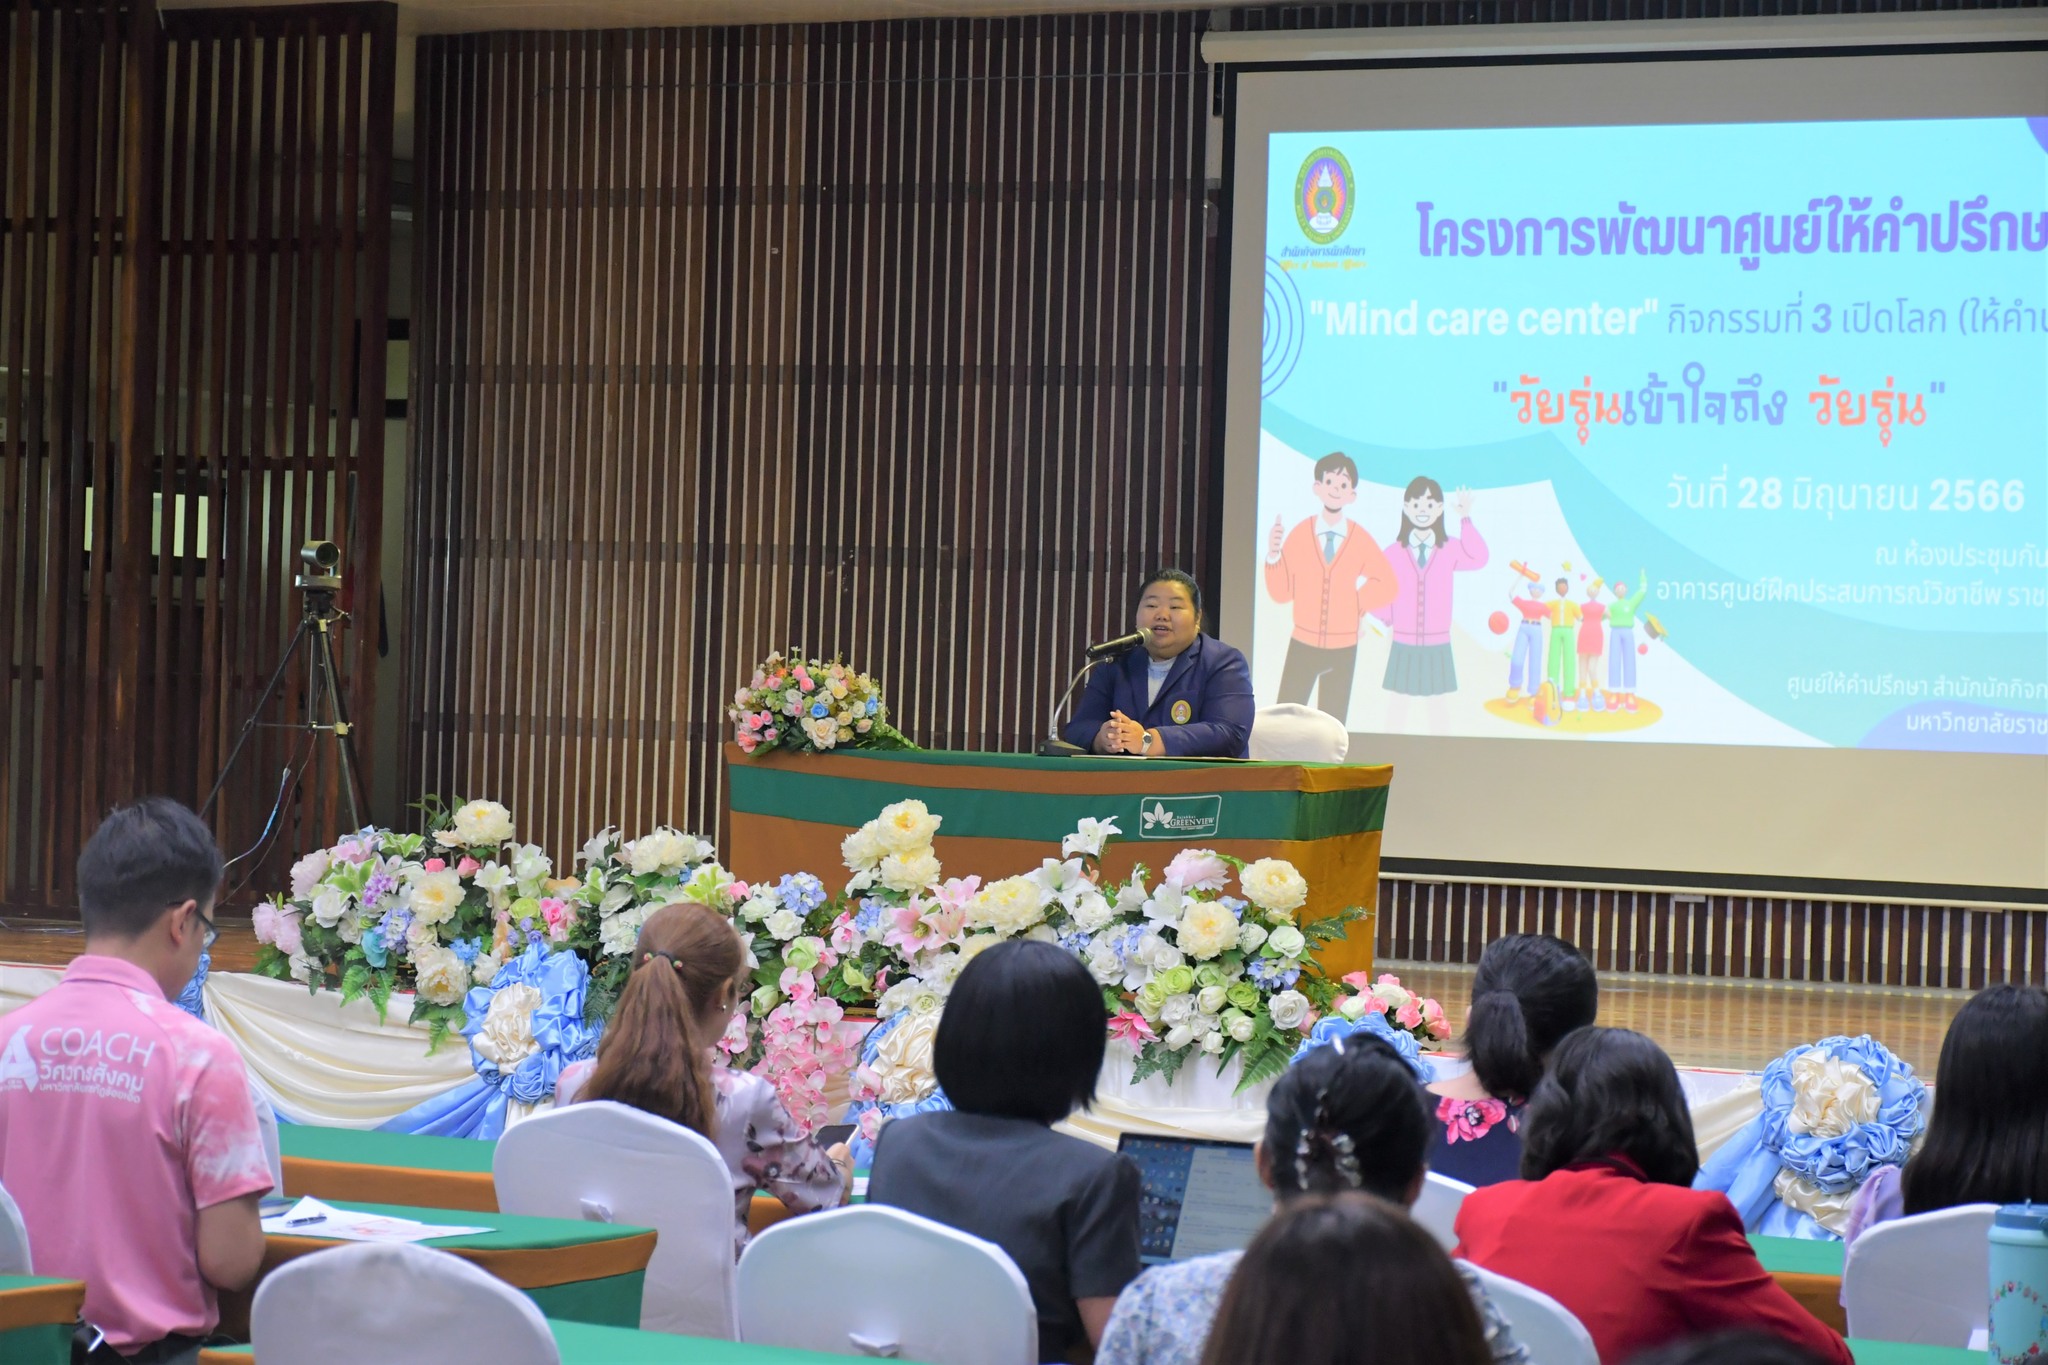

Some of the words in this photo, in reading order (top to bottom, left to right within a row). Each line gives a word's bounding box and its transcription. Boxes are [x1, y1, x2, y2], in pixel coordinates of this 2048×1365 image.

[1416, 194, 2048, 271] โครงการพัฒนาศูนย์ให้คำปรึกษ
[1310, 299, 1418, 336] "Mind
[1426, 308, 1509, 336] care
[1517, 298, 1659, 336] center"
[1668, 290, 1803, 334] กิจกรรมที่
[1812, 303, 1832, 333] 3
[1842, 298, 1947, 334] เปิดโลก
[1666, 464, 1728, 509] วันที่
[1738, 477, 1783, 509] 28
[1792, 477, 1919, 521] มิถุนายน
[1929, 479, 2026, 513] 2566
[1875, 546, 1898, 566] ณ
[2007, 586, 2048, 608] ราช
[1787, 671, 1928, 700] ศูนย์ให้คำปรึกษา
[40, 1027, 156, 1068] COACH
